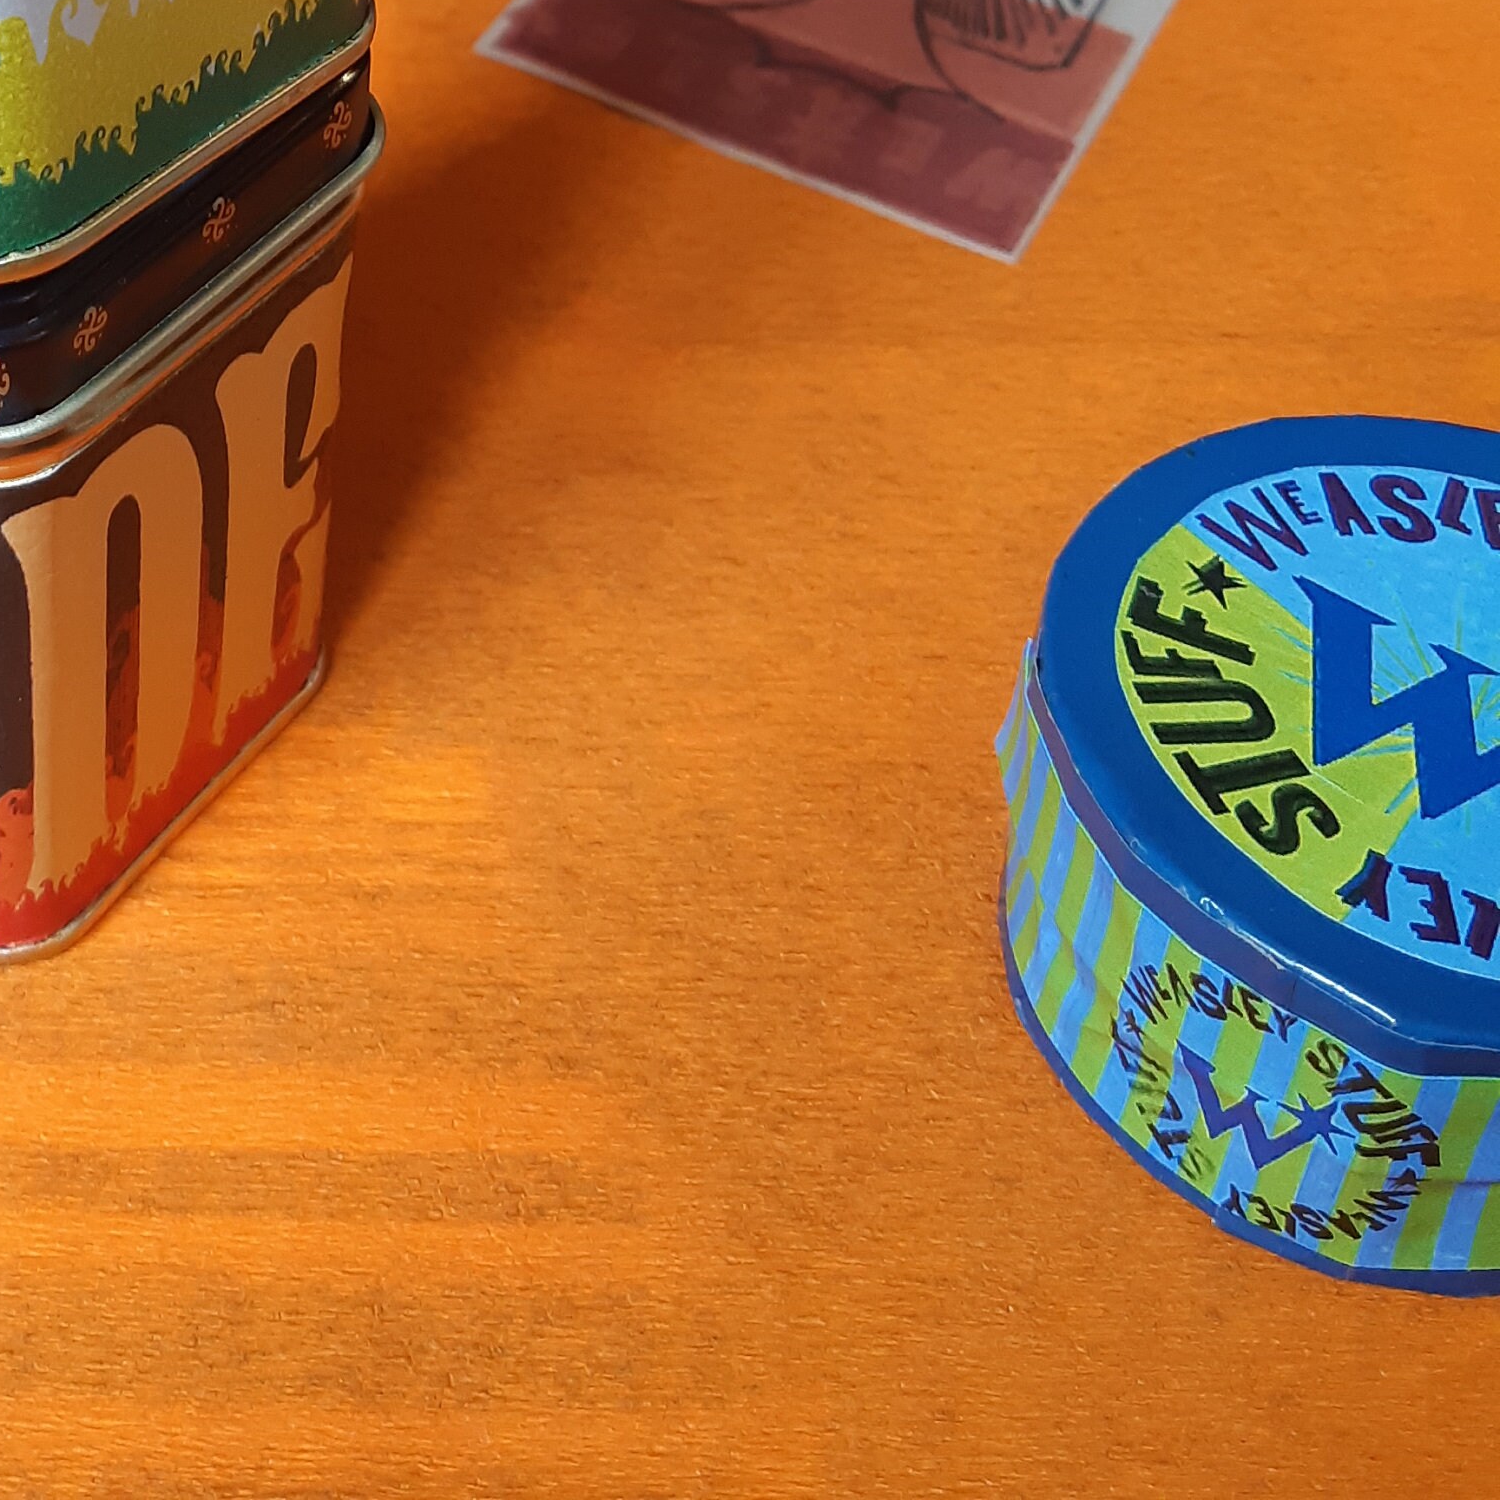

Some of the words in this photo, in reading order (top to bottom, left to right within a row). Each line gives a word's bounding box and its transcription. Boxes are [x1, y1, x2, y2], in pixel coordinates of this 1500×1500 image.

[1121, 575, 1341, 857] STUFF
[1121, 961, 1298, 1044] WEASLEY
[1305, 1038, 1442, 1167] STUFF
[1218, 1182, 1422, 1241] WEASLEY
